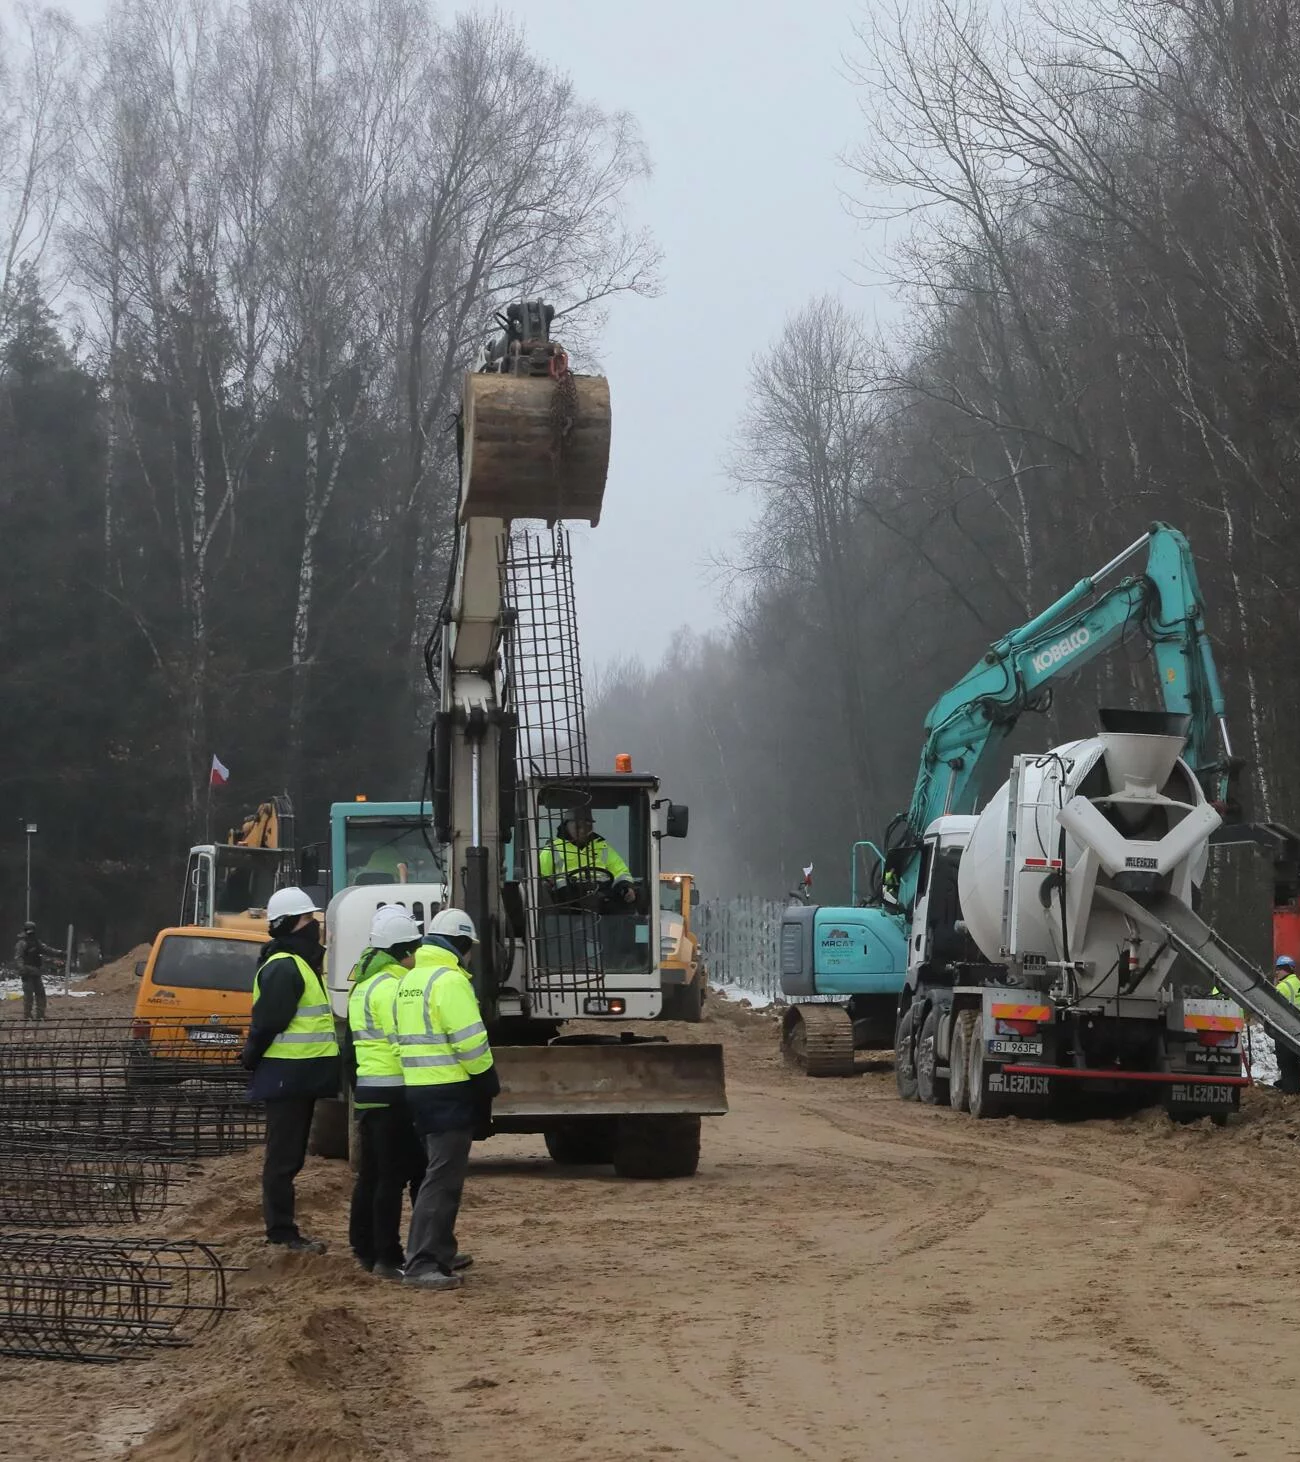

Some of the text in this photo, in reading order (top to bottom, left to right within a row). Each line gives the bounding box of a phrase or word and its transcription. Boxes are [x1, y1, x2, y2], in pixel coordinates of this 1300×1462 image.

[1032, 626, 1090, 674] KOBELCO
[821, 940, 856, 948] MRCAT
[1195, 1053, 1232, 1064] MAN
